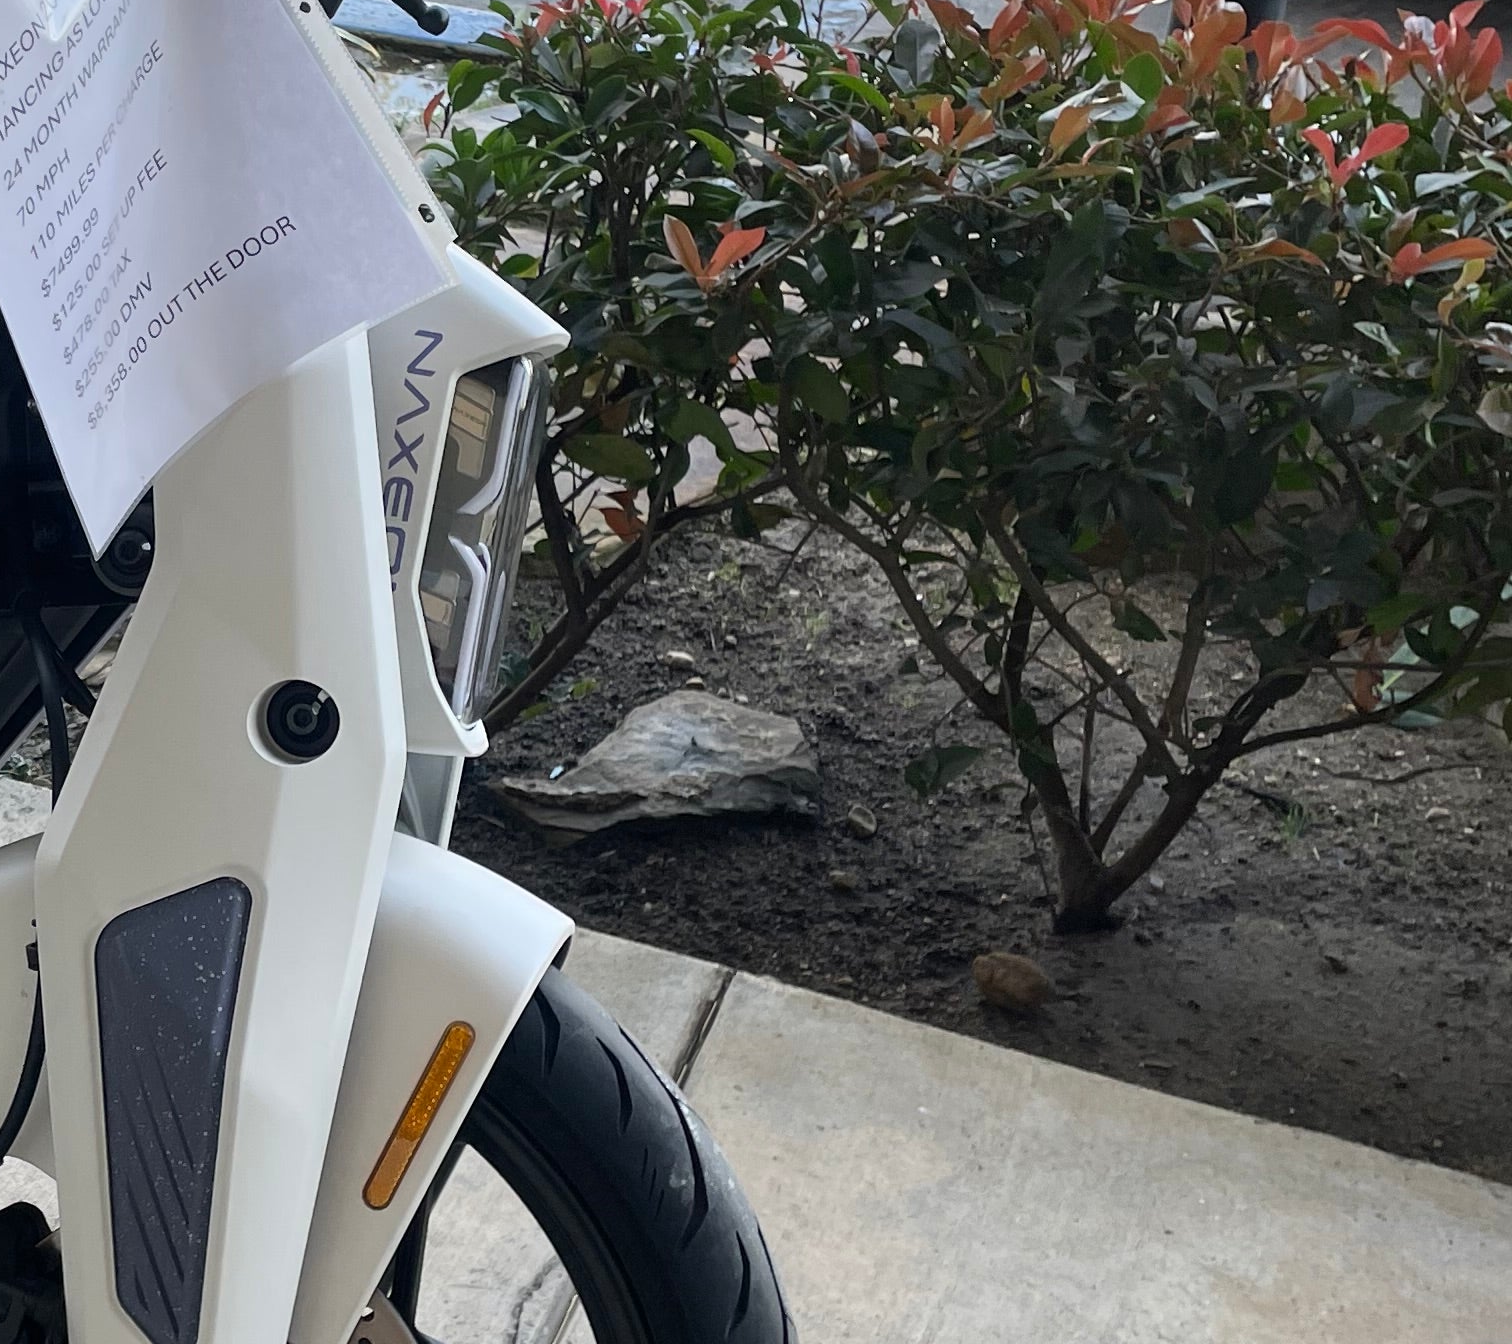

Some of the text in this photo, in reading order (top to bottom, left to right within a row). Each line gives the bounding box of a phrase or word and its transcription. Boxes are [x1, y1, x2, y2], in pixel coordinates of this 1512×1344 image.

[66, 22, 83, 56] AS
[3, 157, 23, 191] 24
[23, 83, 79, 165] MONTH
[16, 148, 71, 227] 70 MPH
[30, 40, 164, 260] 110 MILES PER CHARGE
[41, 207, 99, 298] $7499.99
[52, 148, 168, 331] $125.00 SET UP FEE
[63, 248, 132, 365] $478.00 TAX
[75, 271, 153, 398] $255.00 DMV
[87, 215, 297, 430] $8,358.00 OUT THE DOOR
[384, 329, 444, 592] NAXEO
